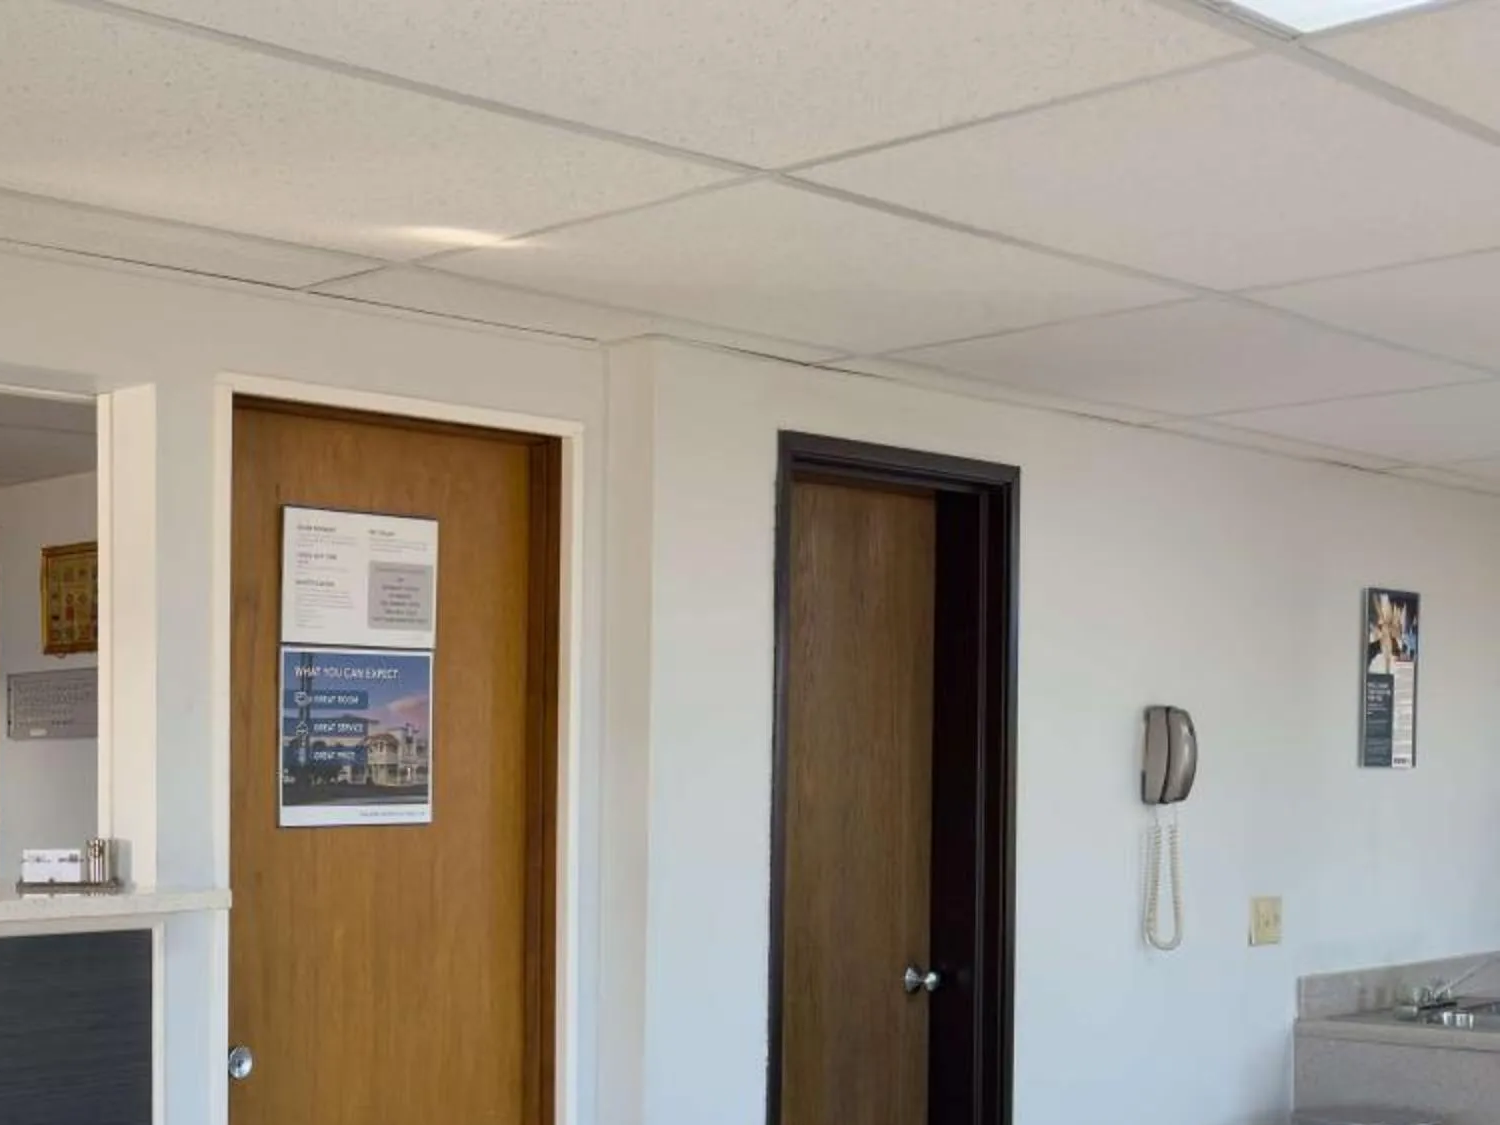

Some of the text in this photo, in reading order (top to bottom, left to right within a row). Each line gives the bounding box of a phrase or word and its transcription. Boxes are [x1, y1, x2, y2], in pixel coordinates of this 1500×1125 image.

[294, 666, 399, 680] WHAT YOU CAN EXPECT
